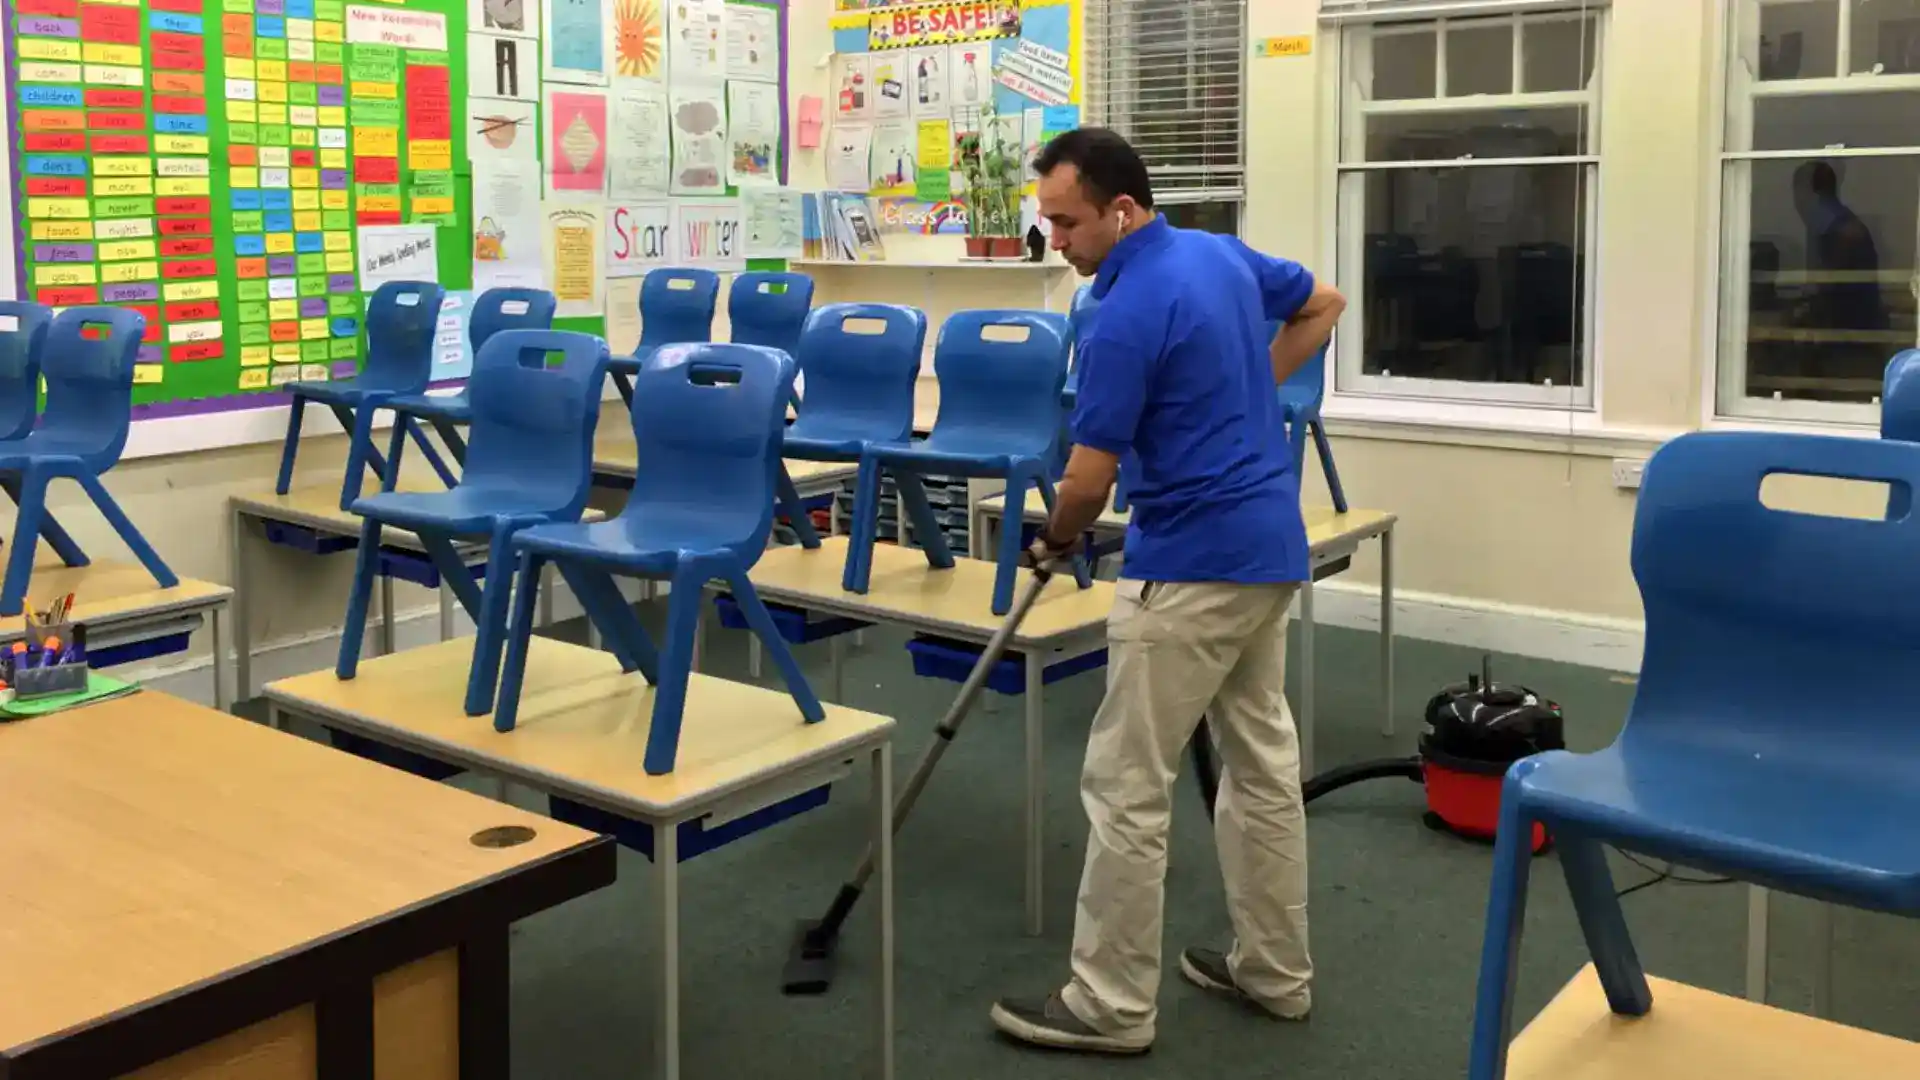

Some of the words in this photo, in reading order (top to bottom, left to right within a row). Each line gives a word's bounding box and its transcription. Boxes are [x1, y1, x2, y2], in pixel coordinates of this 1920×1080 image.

[893, 12, 921, 36] BE
[926, 4, 994, 33] SAFE!
[27, 90, 76, 104] children
[884, 204, 937, 226] Class
[613, 207, 668, 260] Star
[686, 216, 738, 258] wrter
